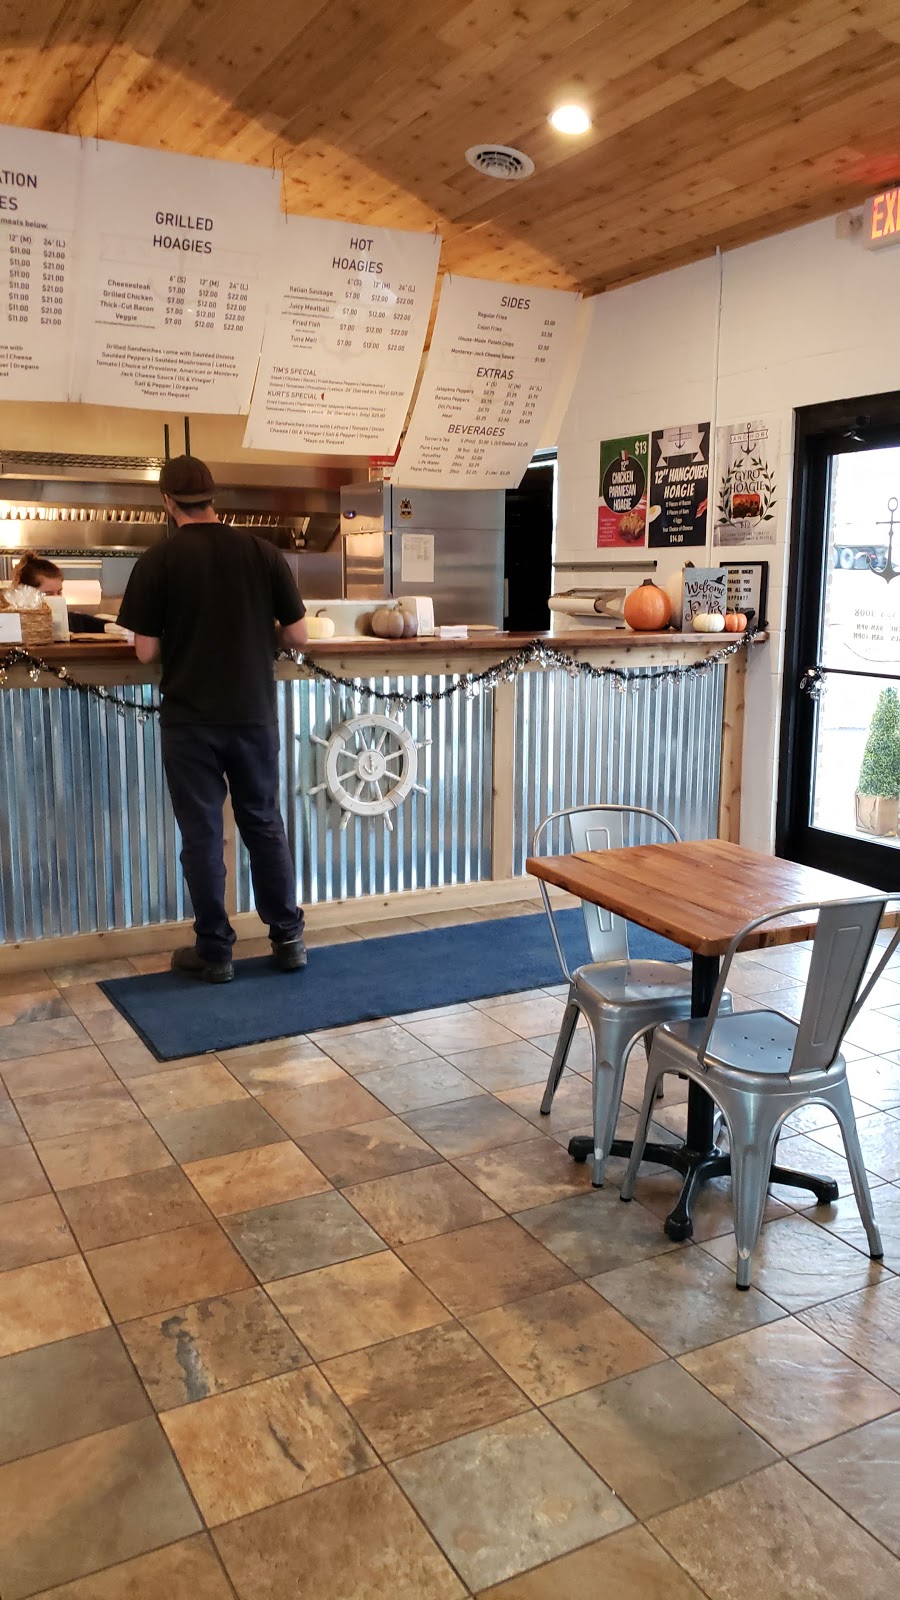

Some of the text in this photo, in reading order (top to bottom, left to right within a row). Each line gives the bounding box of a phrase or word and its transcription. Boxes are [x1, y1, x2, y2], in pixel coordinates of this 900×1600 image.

[0, 170, 37, 188] TION
[156, 211, 213, 231] GRILLED
[153, 235, 212, 254] HOAGIES
[350, 238, 373, 251] HOT
[10, 246, 65, 259] $11.00 $21.00
[10, 258, 64, 271] $11.00 $21.00
[332, 257, 383, 274] HOAGIES
[10, 270, 64, 282] $11.00 $21.00
[9, 281, 64, 293] $11.00 $21.00
[108, 279, 248, 301] Cheesesteak $7.00 $12.00 $22.00
[9, 292, 63, 304] $11.00 $21.00
[103, 290, 246, 311] Grilled Chicken $7.00 $12.00 $22.00
[290, 286, 308, 294] Italian
[309, 288, 333, 296] Sausage
[396, 297, 414, 305] $22.00
[9, 303, 62, 315] $11.00 $21.00
[134, 302, 154, 312] Bacon
[166, 307, 183, 315] $7.00
[304, 304, 329, 312] Meatball
[501, 296, 530, 310] SIDES
[8, 314, 61, 325] $11.00 $21.00
[116, 313, 137, 321] Veggie
[165, 318, 182, 326] $7.00
[195, 321, 214, 329] $12.00
[127, 346, 162, 354] Sandwiches
[127, 354, 151, 362] Peppers
[476, 367, 515, 380] EXTRAS
[448, 424, 505, 436] BEVERAGES
[733, 432, 765, 441] ANCHOR
[635, 441, 646, 455] $13
[612, 471, 634, 484] CHICKEN
[655, 464, 709, 485] 12" HANGOVER
[735, 469, 760, 482] GYRO
[609, 484, 636, 498] PARMESAN
[664, 483, 695, 499] HOAGIE
[730, 481, 765, 494] HOAGIE
[614, 498, 632, 511] HOAGIE
[685, 580, 725, 596] Welcome
